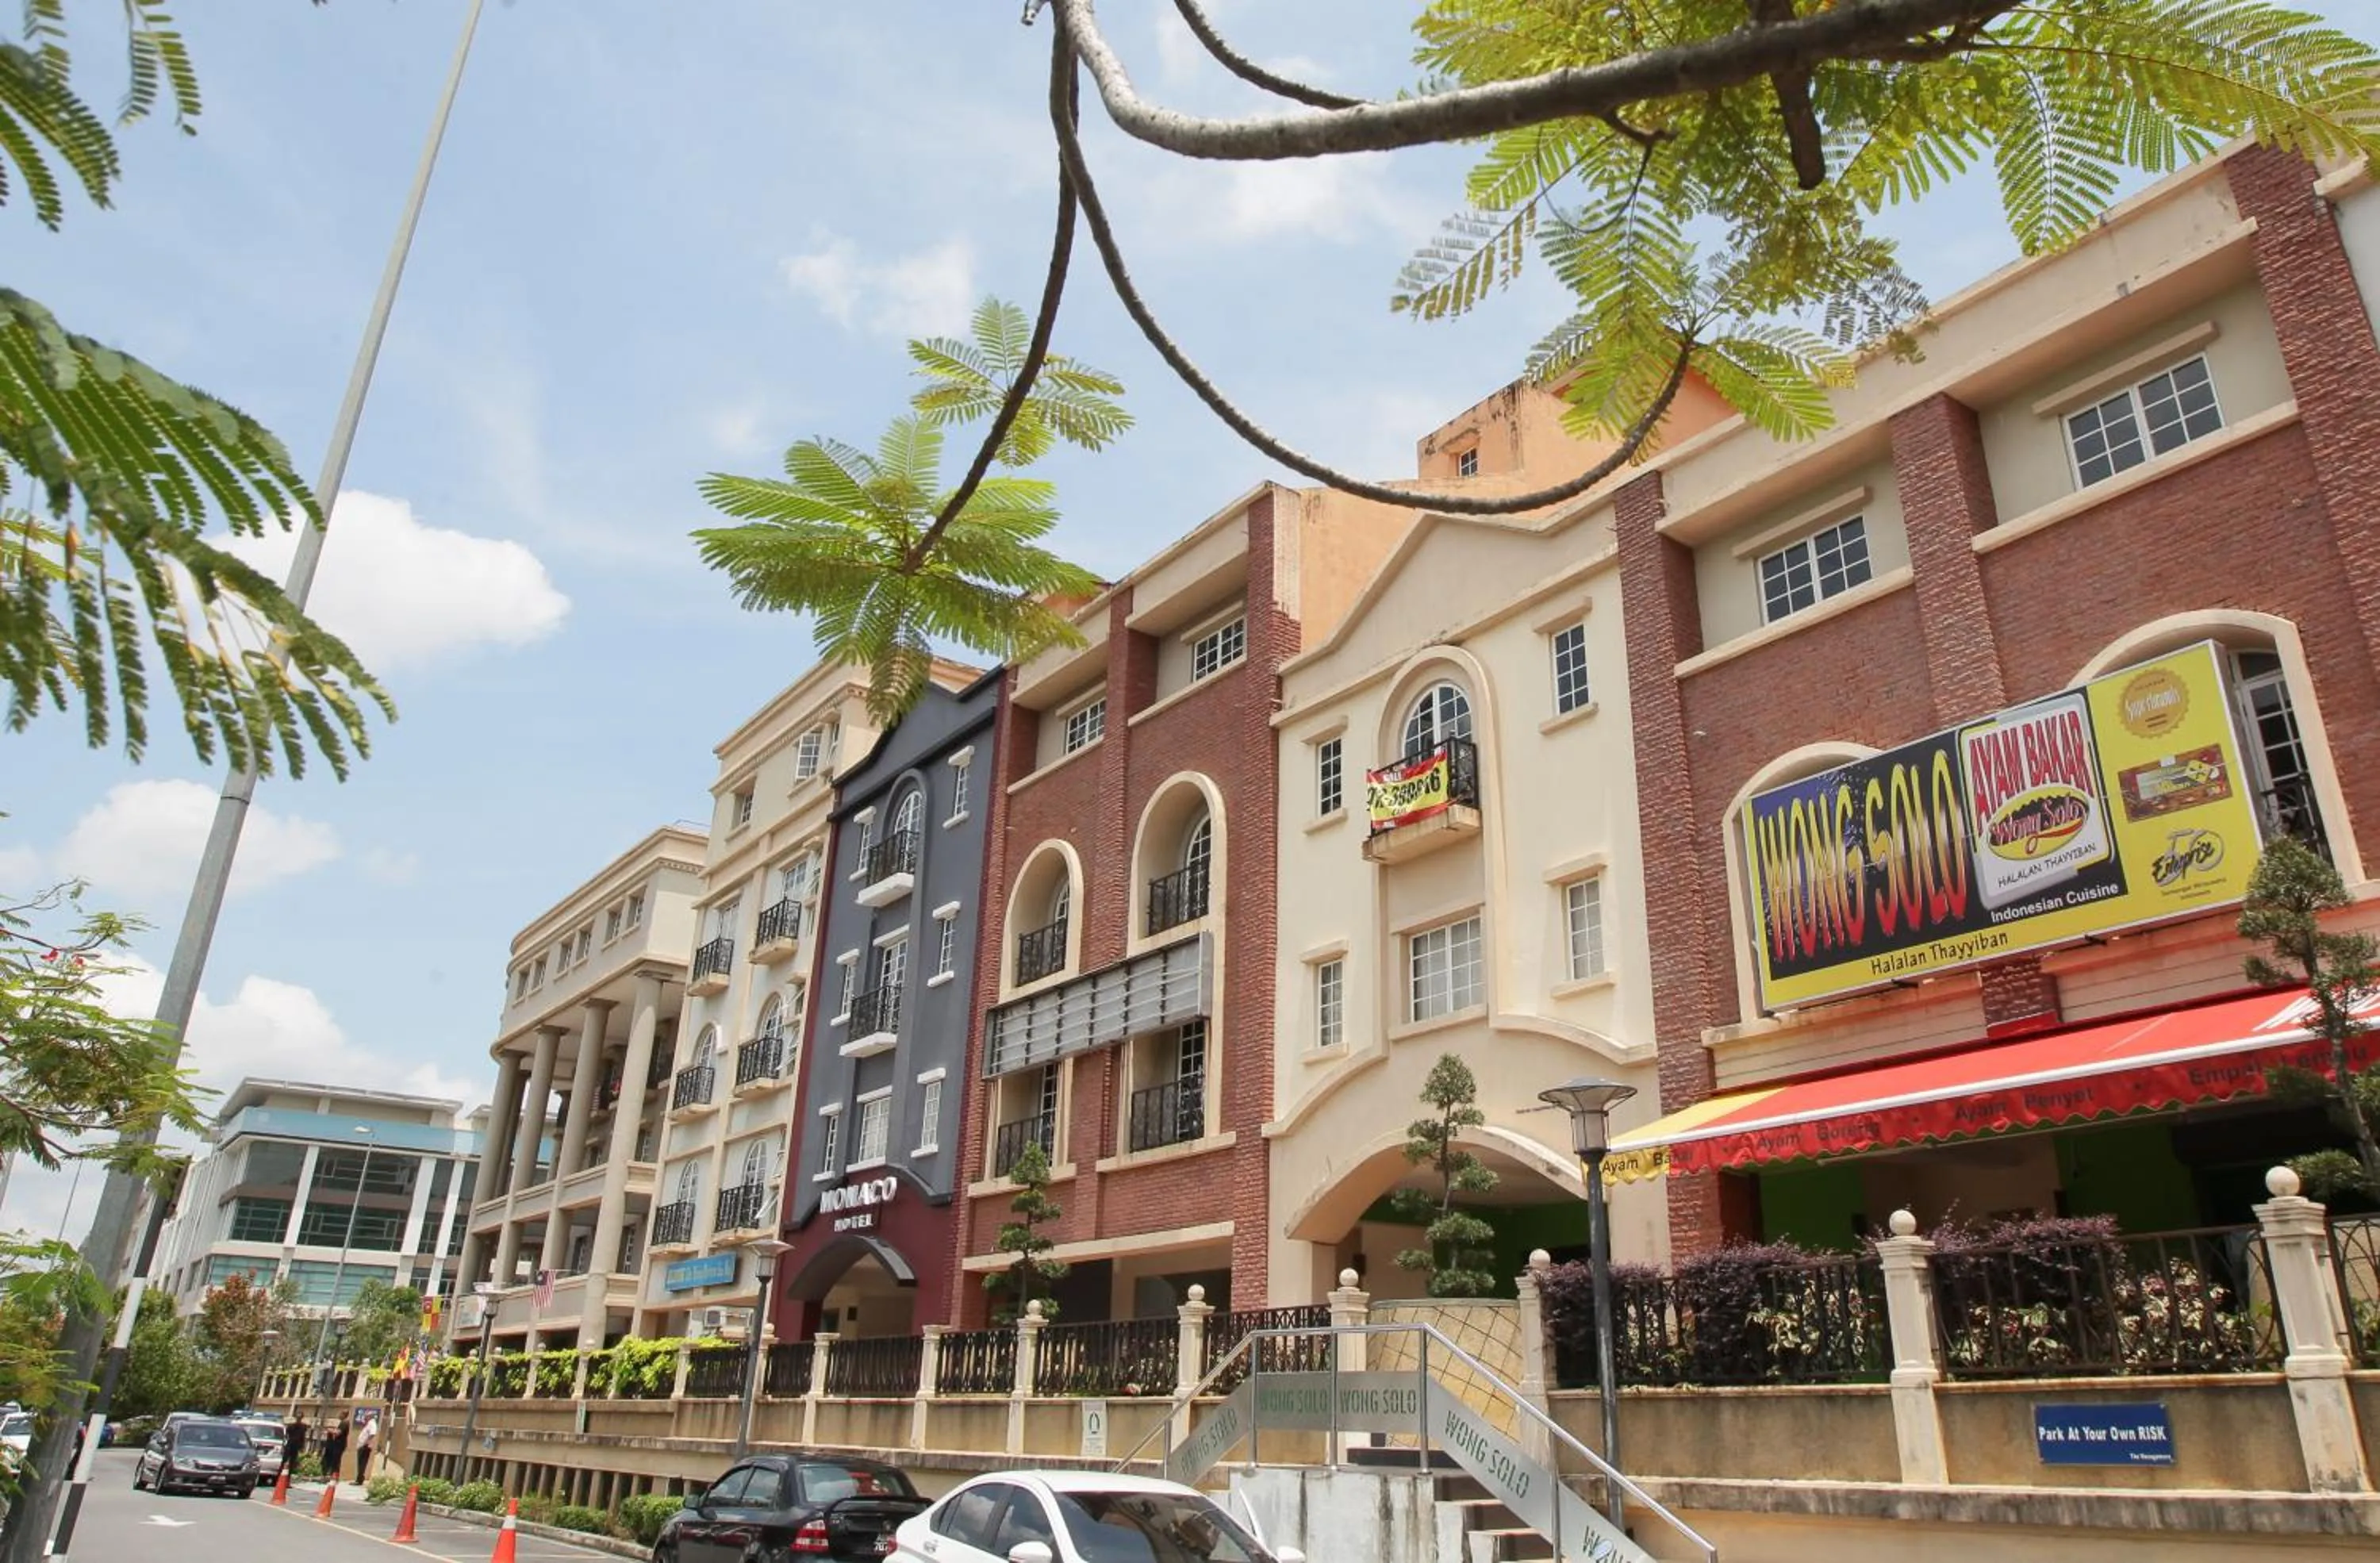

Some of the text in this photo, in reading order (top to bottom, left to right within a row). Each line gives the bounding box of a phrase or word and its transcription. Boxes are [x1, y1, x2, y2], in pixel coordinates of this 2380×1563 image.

[1968, 710, 2095, 836] AYAM BAKAR
[1990, 795, 2086, 851] Wong Solo
[1758, 748, 1967, 963] WONG SOLO
[1998, 843, 2097, 888] HALALAN THAYYIBAN
[1990, 882, 2119, 923] Indonesian Cuisine
[1870, 931, 2009, 976] Halalan Thayyiban
[1602, 1158, 1638, 1175] Ayam
[1756, 1131, 1803, 1152] Ayam
[1954, 1100, 2007, 1121] Ayam
[2025, 1088, 2094, 1110] Penyet
[820, 1176, 898, 1214] MONACO
[834, 1213, 873, 1232] HOTEL
[1259, 1389, 1328, 1414] WONG SOLO
[1340, 1388, 1417, 1415] WONG SOLO
[1211, 1407, 1238, 1450] SOLO
[2038, 1425, 2167, 1442] Park At Your Own RISK
[1444, 1409, 1530, 1500] WONG SOLO
